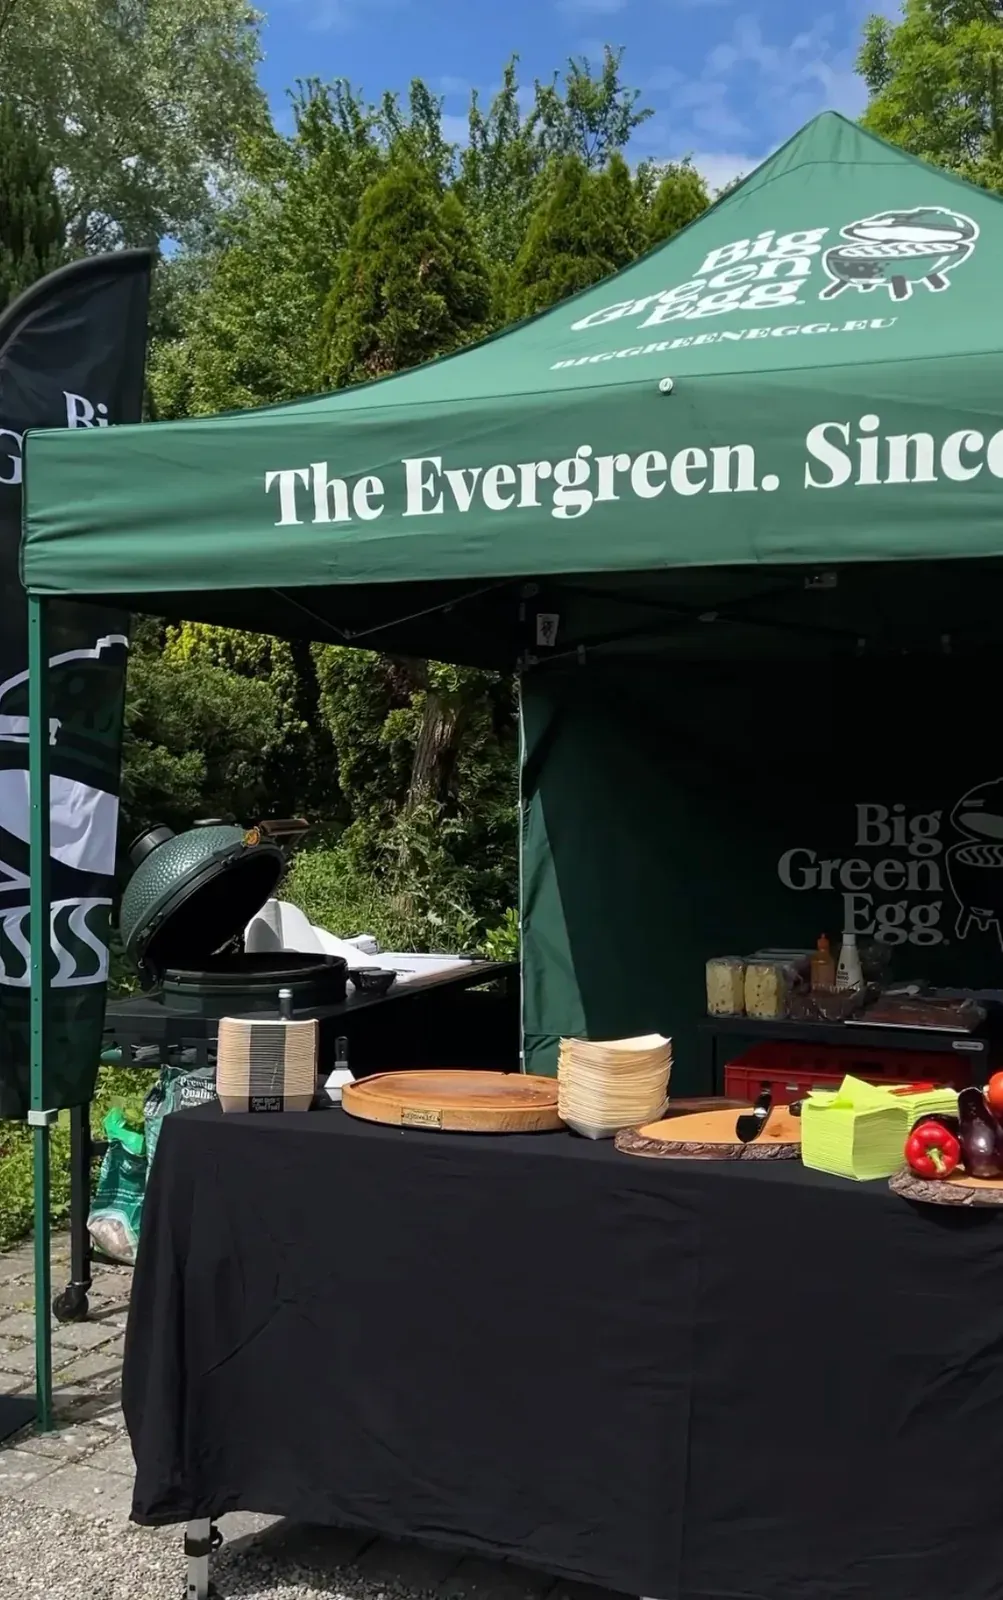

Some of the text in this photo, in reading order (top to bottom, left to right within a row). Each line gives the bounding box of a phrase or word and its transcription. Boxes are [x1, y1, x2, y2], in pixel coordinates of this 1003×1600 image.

[692, 227, 830, 278] Big
[571, 256, 812, 331] Green
[549, 316, 899, 371] BIGGREENEGG.EU
[265, 461, 385, 526] The
[402, 444, 780, 519] Evergreen.
[855, 803, 944, 857] Big
[777, 847, 944, 891] Green
[841, 892, 944, 946] Egg
